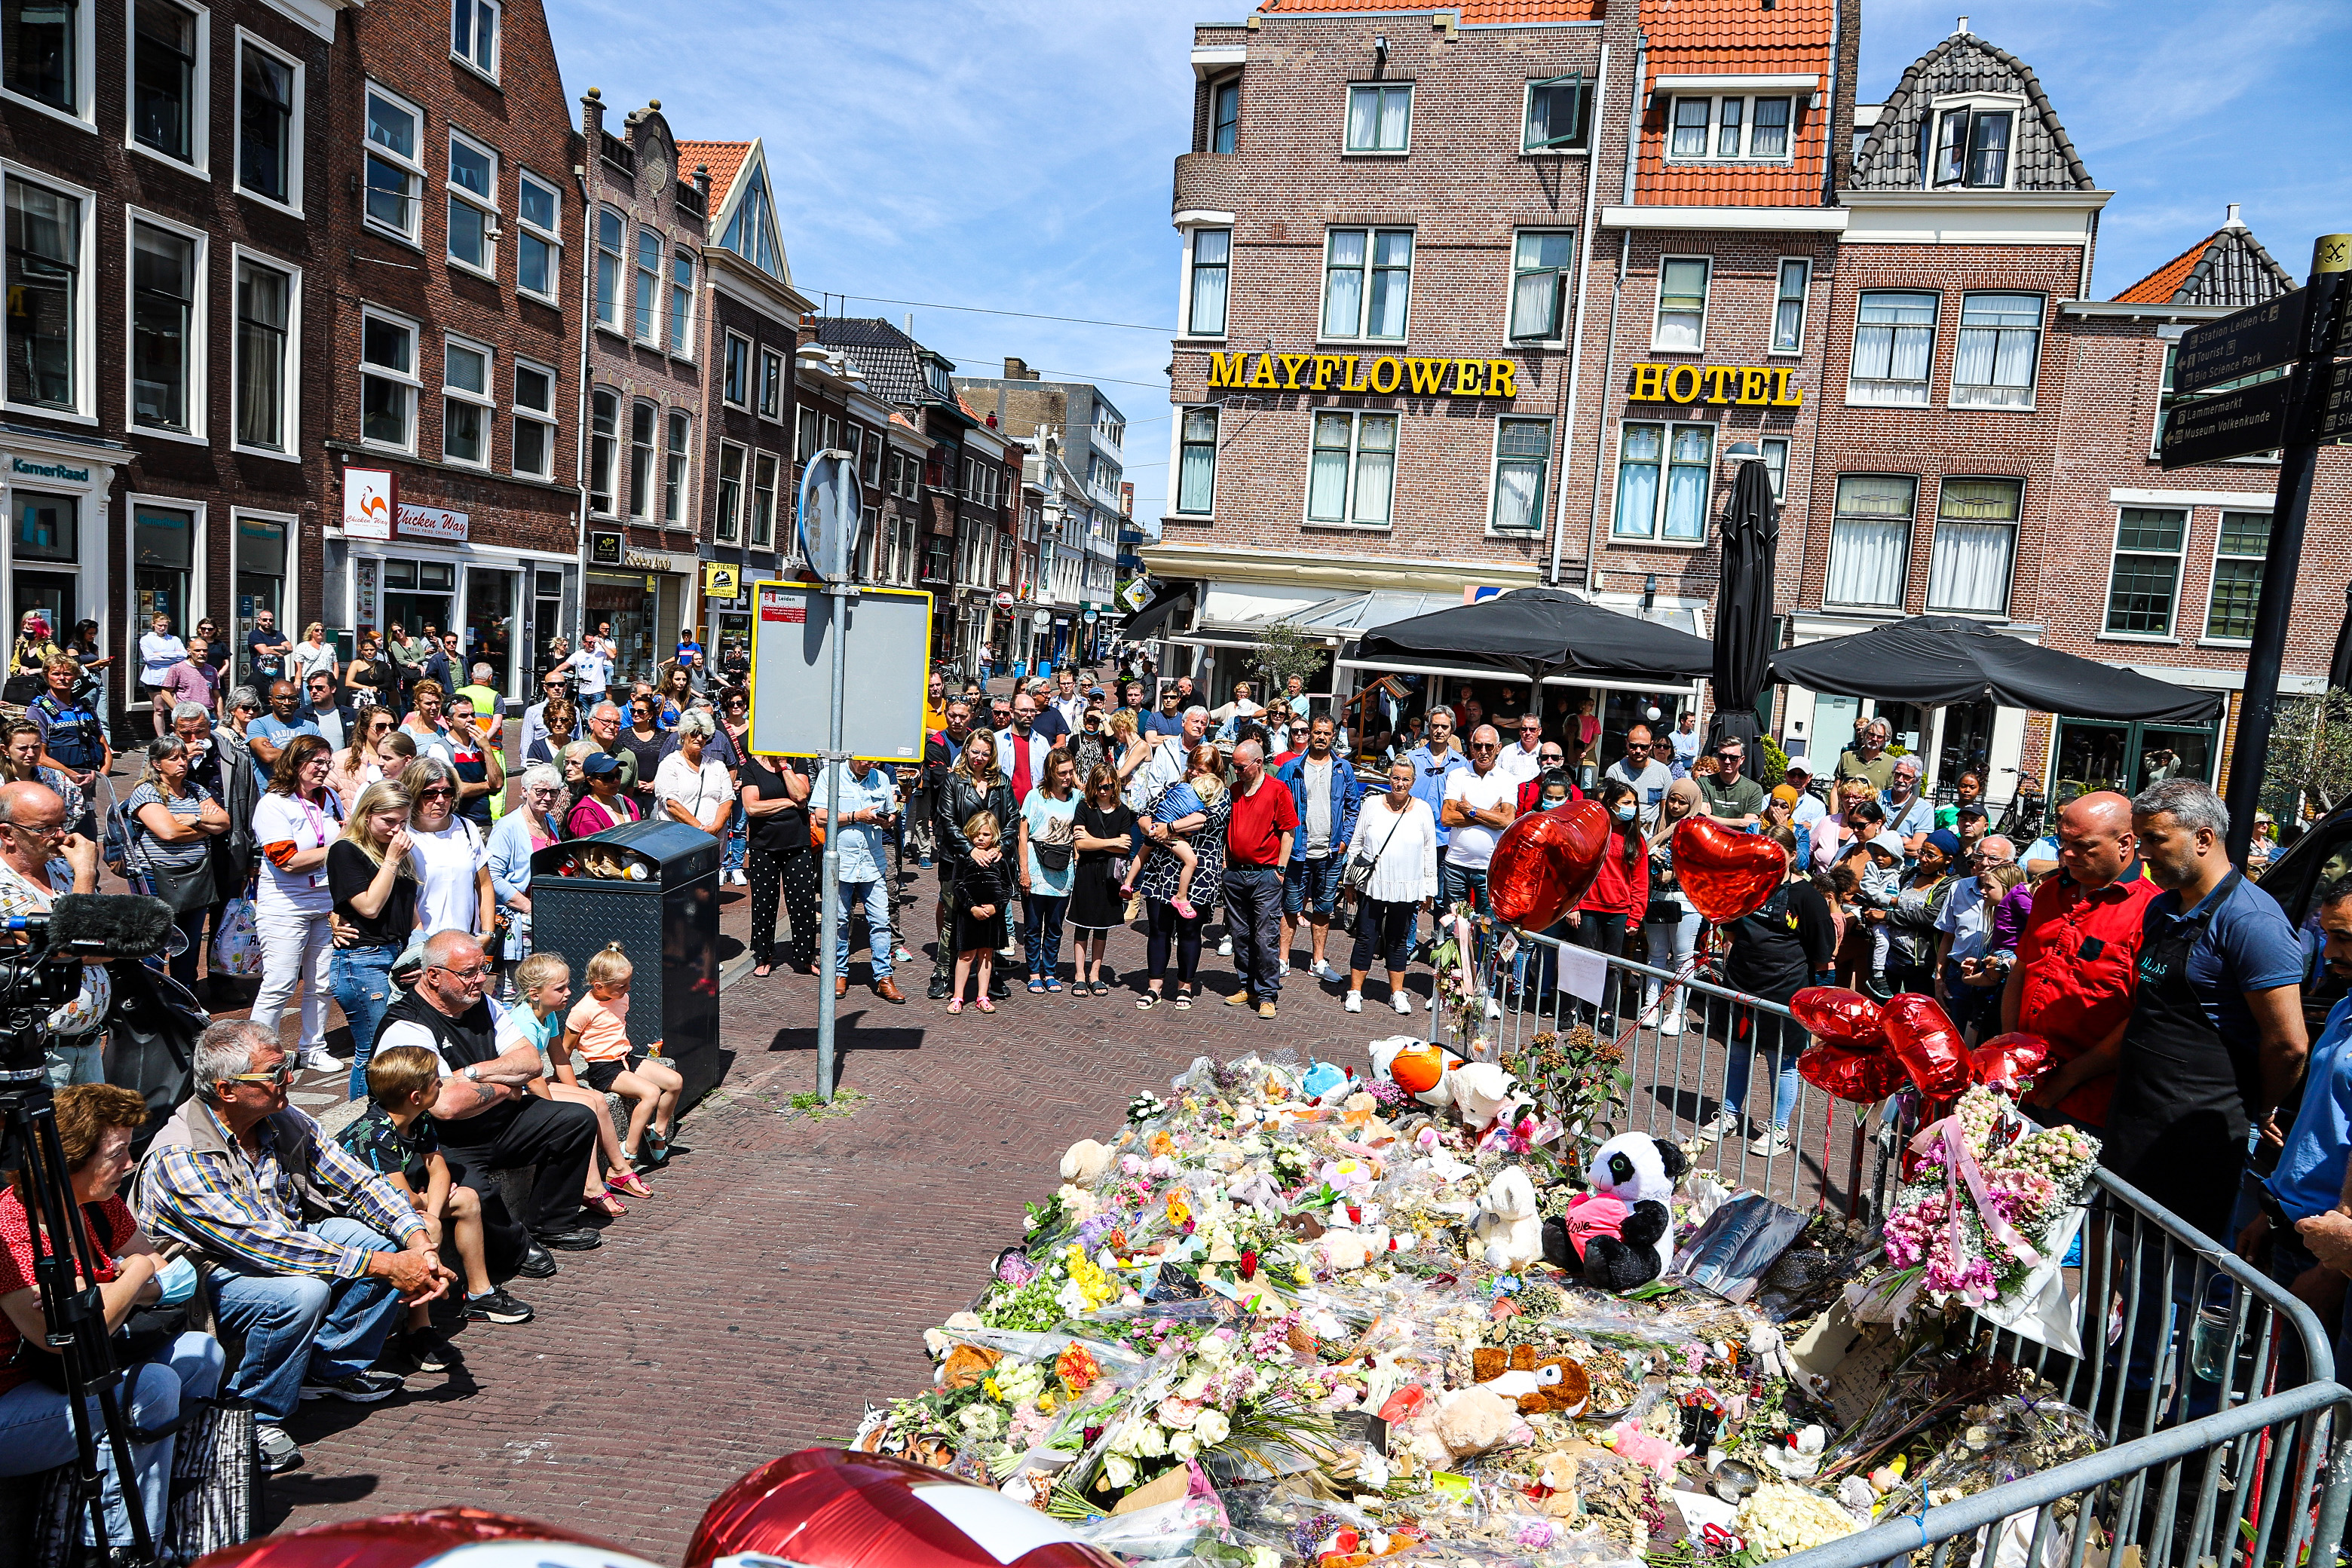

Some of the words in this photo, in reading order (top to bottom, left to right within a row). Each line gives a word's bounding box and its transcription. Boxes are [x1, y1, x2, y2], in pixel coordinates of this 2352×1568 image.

[2199, 326, 2228, 344] Station
[2230, 315, 2258, 332] Leiden
[2261, 310, 2267, 322] C
[2197, 346, 2224, 362] Tourist
[1208, 352, 1518, 398] MAYFLOWER
[1629, 363, 1803, 406] HOTEL
[2194, 371, 2207, 383] Bio
[2209, 361, 2240, 378] Science
[2241, 351, 2262, 368] Park
[2187, 397, 2243, 421] Lammermarkt
[2184, 424, 2216, 439] Museum
[2218, 410, 2271, 432] Volkenkunde
[13, 458, 89, 482] KamerRaad
[138, 514, 185, 528] KamerRaad
[240, 526, 280, 539] KamerRaad
[345, 515, 371, 524] Chicken
[373, 517, 388, 526] Way
[397, 507, 436, 529] Chicken
[441, 513, 466, 536] Way
[630, 553, 652, 569] Selera
[653, 555, 672, 571] Anda
[31, 1107, 51, 1116] sachtler
